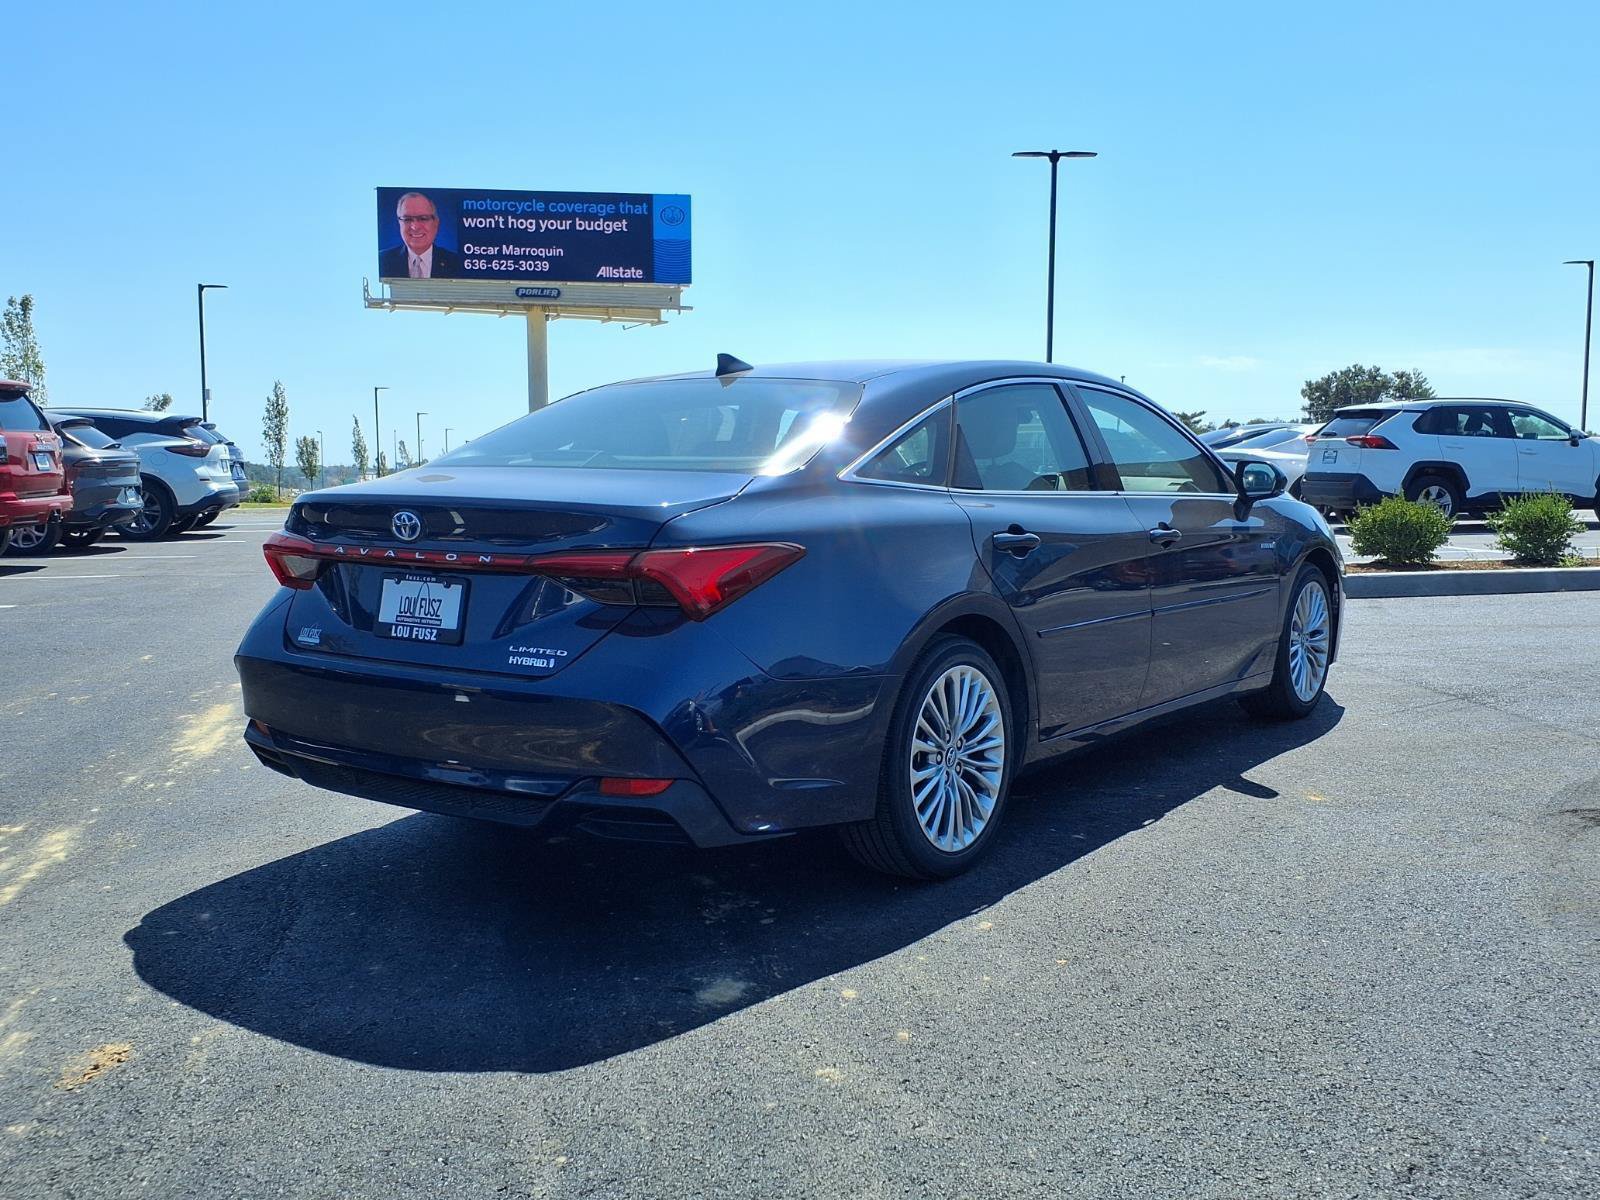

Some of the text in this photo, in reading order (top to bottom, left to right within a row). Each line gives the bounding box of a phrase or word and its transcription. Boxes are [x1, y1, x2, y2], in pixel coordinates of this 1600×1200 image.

[463, 198, 648, 216] motorcycle coverage that
[463, 216, 627, 233] won't hog your budget
[464, 244, 564, 259] Oscar Marroquin
[464, 259, 549, 272] 636-625-3039
[596, 266, 643, 279] Allstate
[518, 288, 559, 297] PORLIER
[334, 546, 492, 563] AVALON
[399, 595, 442, 617] LOU FUSZ
[391, 624, 437, 641] LOU FUSZ
[509, 645, 568, 656] LIMITED
